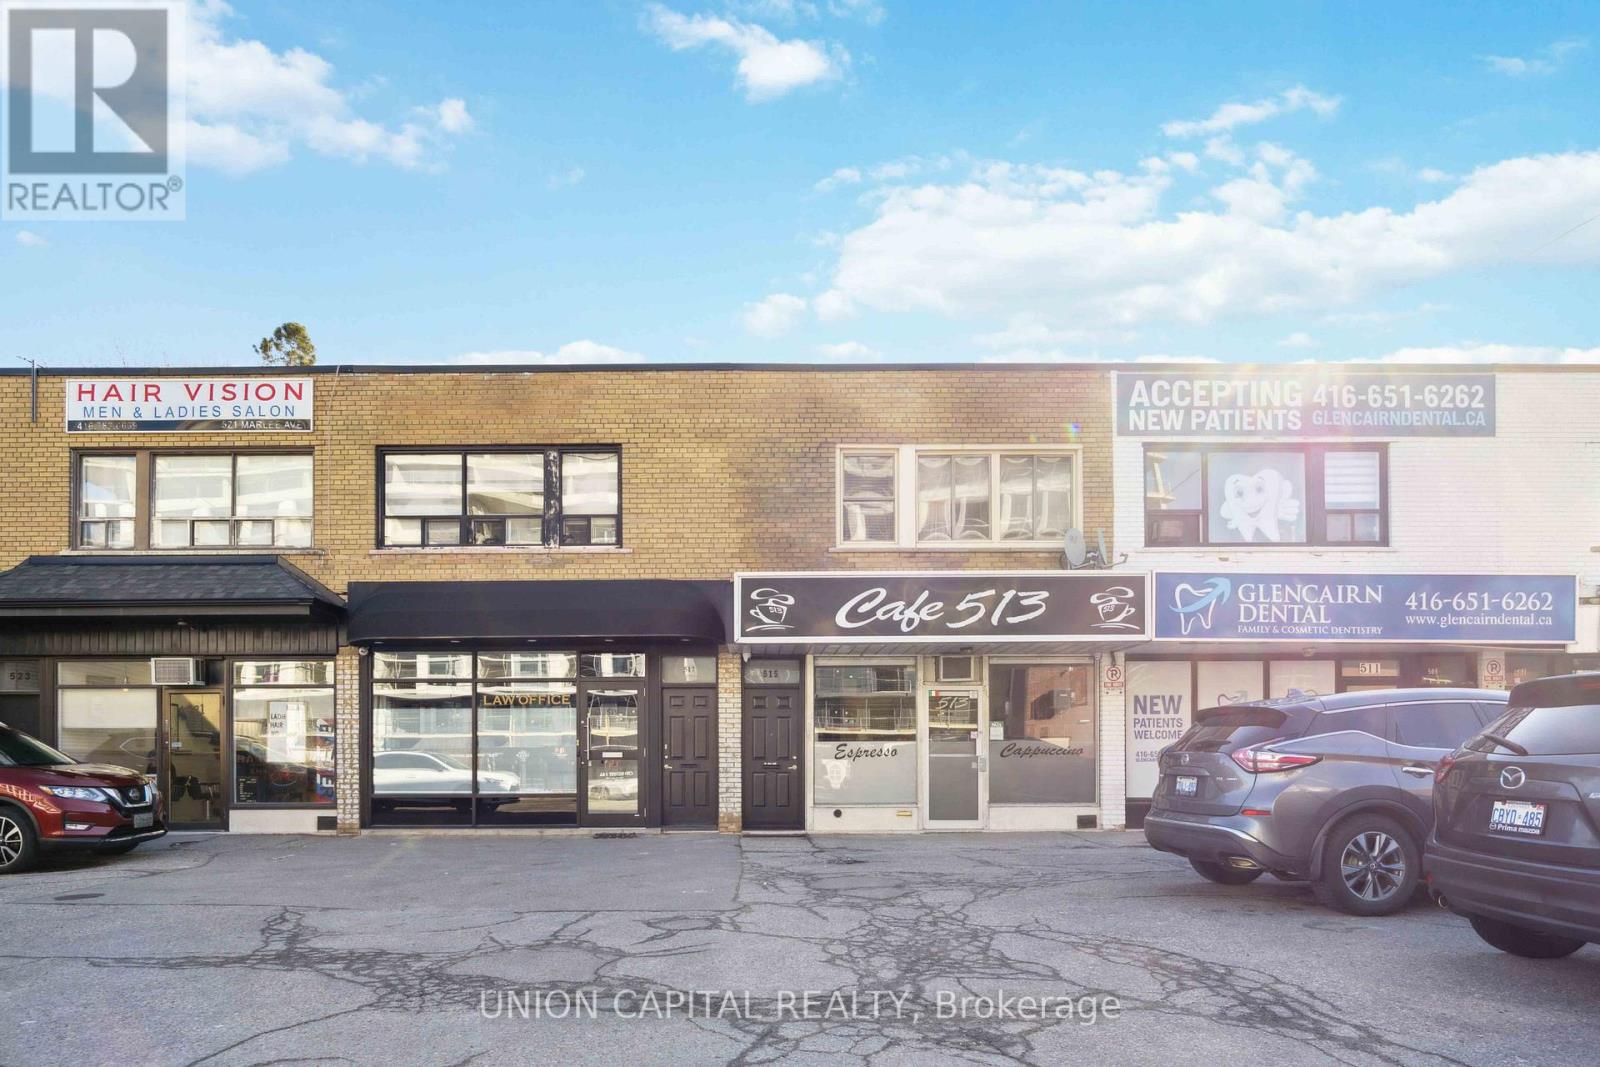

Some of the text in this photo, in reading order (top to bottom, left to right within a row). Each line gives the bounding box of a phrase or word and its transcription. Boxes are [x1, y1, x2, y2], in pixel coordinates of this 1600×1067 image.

[78, 383, 304, 401] HAIR VISION
[1129, 379, 1302, 407] ACCEPTING
[1313, 384, 1485, 409] 416-651-6262
[83, 405, 295, 419] MEN & LADIES SALON
[1129, 409, 1302, 431] NEW PATIENTS
[1312, 410, 1486, 427] GLENCAIRNDENTAL.CA
[1237, 583, 1384, 604] GLENCAIRN
[1405, 591, 1553, 611] 416-651-6262
[834, 587, 1050, 633] Cafe 513
[1238, 604, 1332, 624] DENTAL
[1405, 613, 1553, 628] www.glencairndental.ca
[1237, 625, 1383, 636] FAMILY & COSMETIC DENTISTRY
[1360, 663, 1380, 674] 511
[483, 694, 571, 705] LAW OFFICE
[935, 696, 969, 710] 513
[1134, 695, 1183, 714] NEW
[1133, 718, 1183, 729] PATIENTS
[1134, 730, 1183, 740] WELCOME
[834, 743, 898, 761] Espresso
[1000, 742, 1084, 759] Cappuccino
